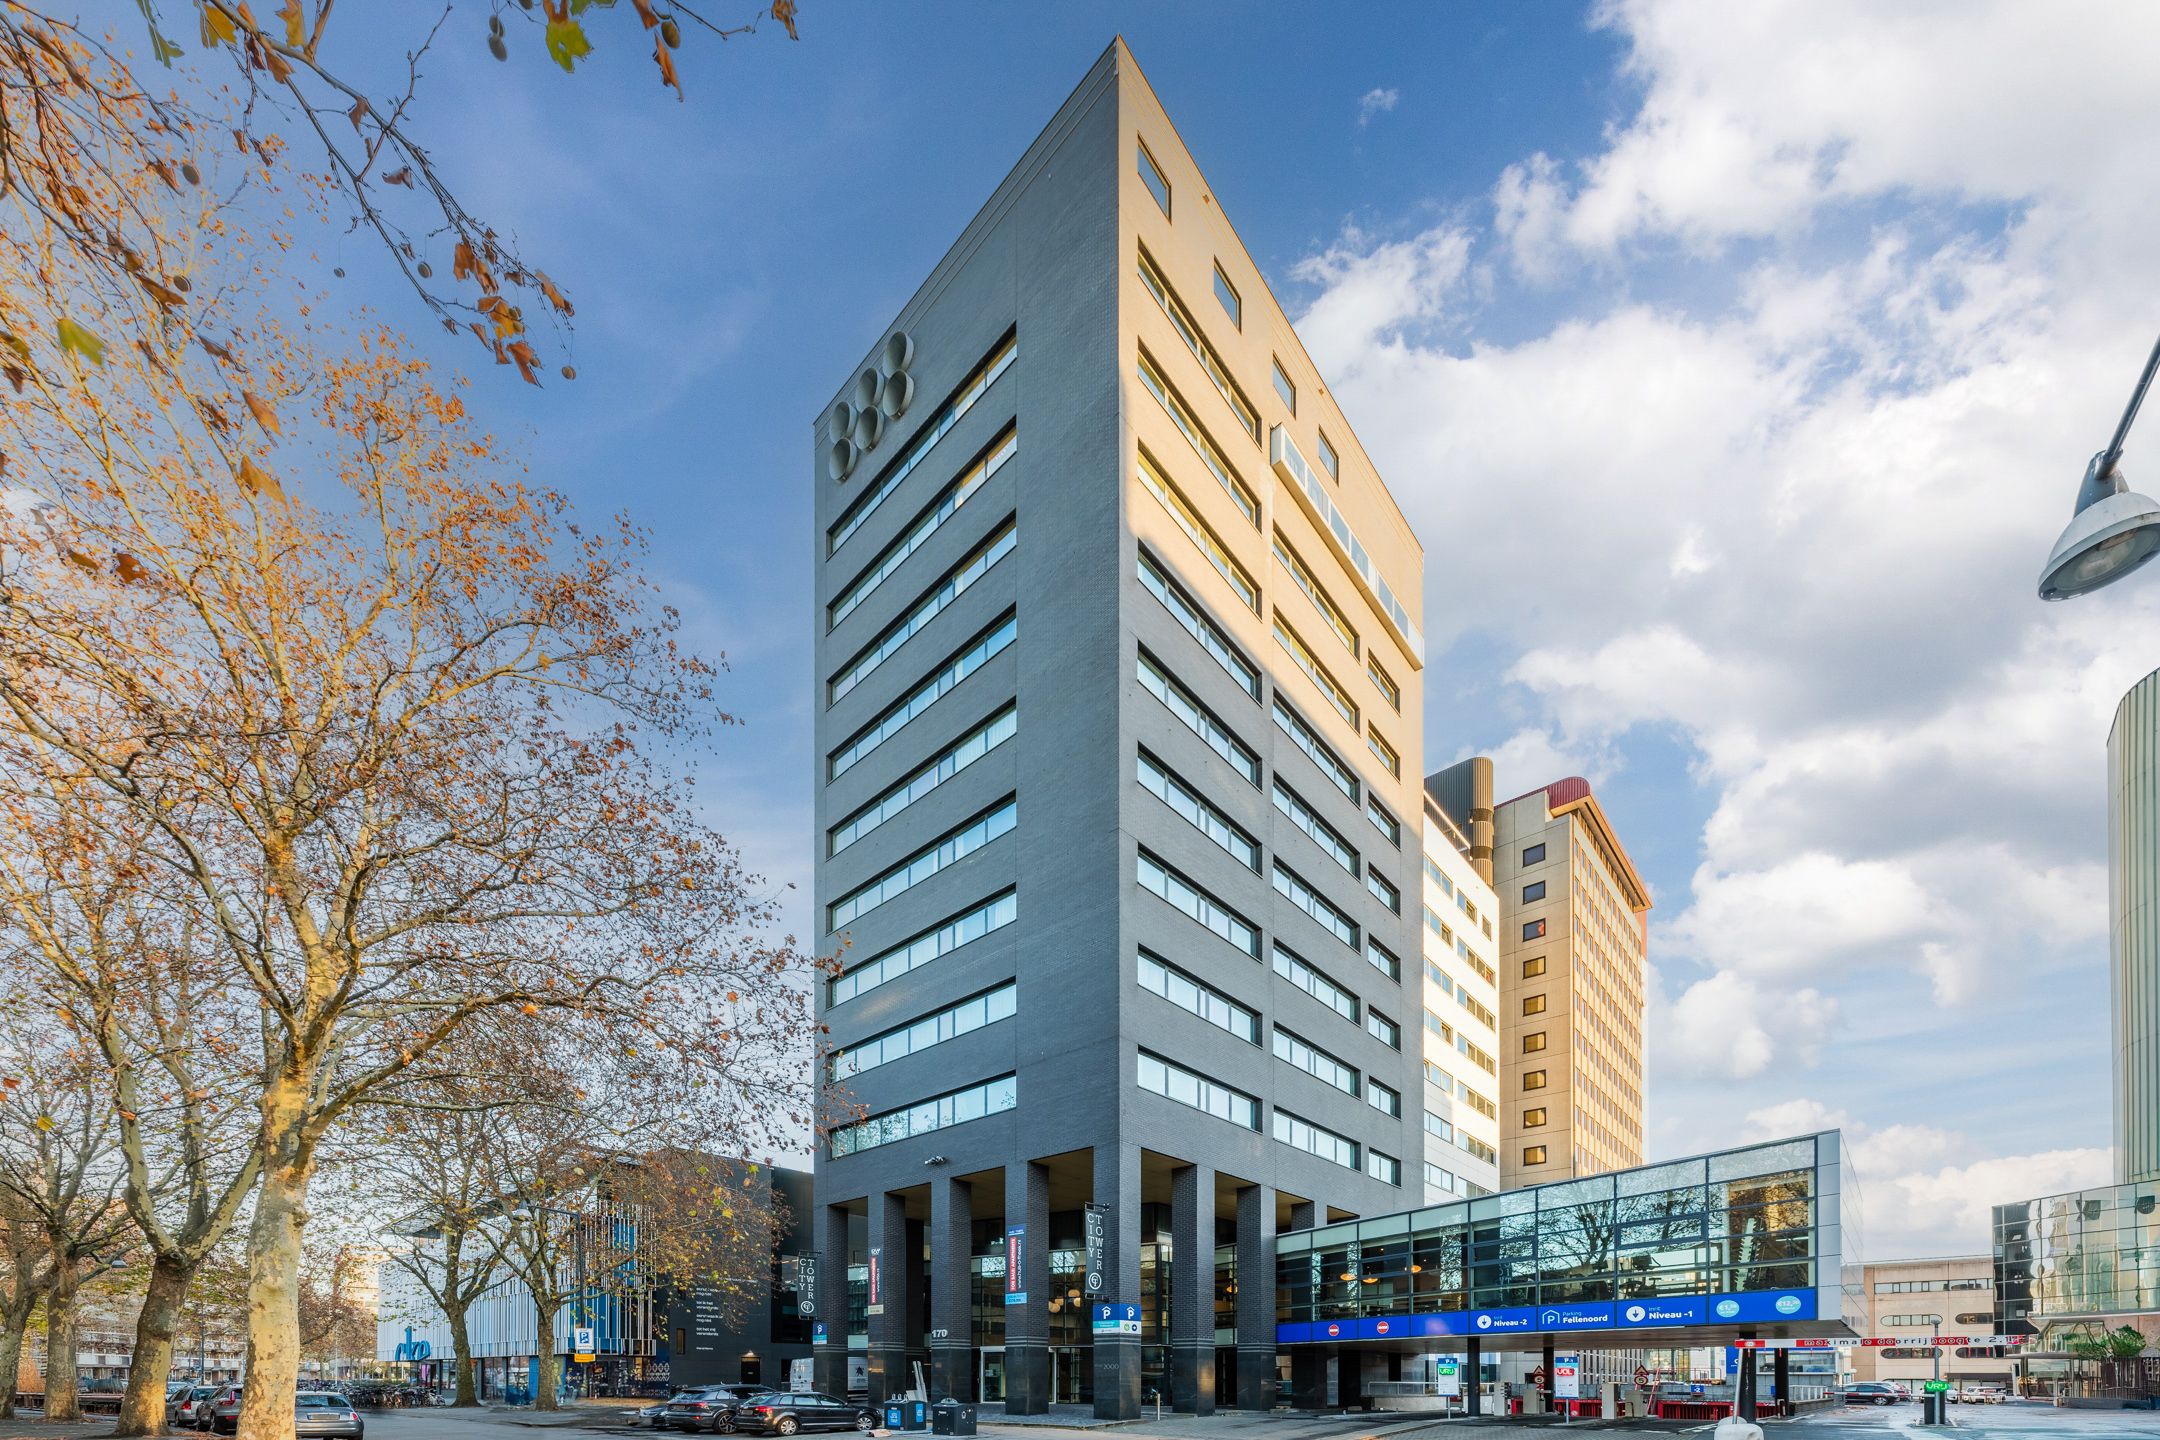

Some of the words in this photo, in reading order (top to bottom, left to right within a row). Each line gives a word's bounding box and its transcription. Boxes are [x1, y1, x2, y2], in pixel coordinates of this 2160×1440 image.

[1087, 1213, 1095, 1258] CITY
[1095, 1214, 1104, 1270] TOWER
[806, 1259, 815, 1300] TOWER
[1562, 1314, 1608, 1324] Fellenoord
[1649, 1311, 1682, 1320] Niveau
[1683, 1310, 1693, 1318] -1
[1519, 1318, 1528, 1326] -2
[931, 1329, 948, 1338] 170
[1804, 1338, 1872, 1346] maximale
[1877, 1336, 1980, 1346] doorrijhoogte
